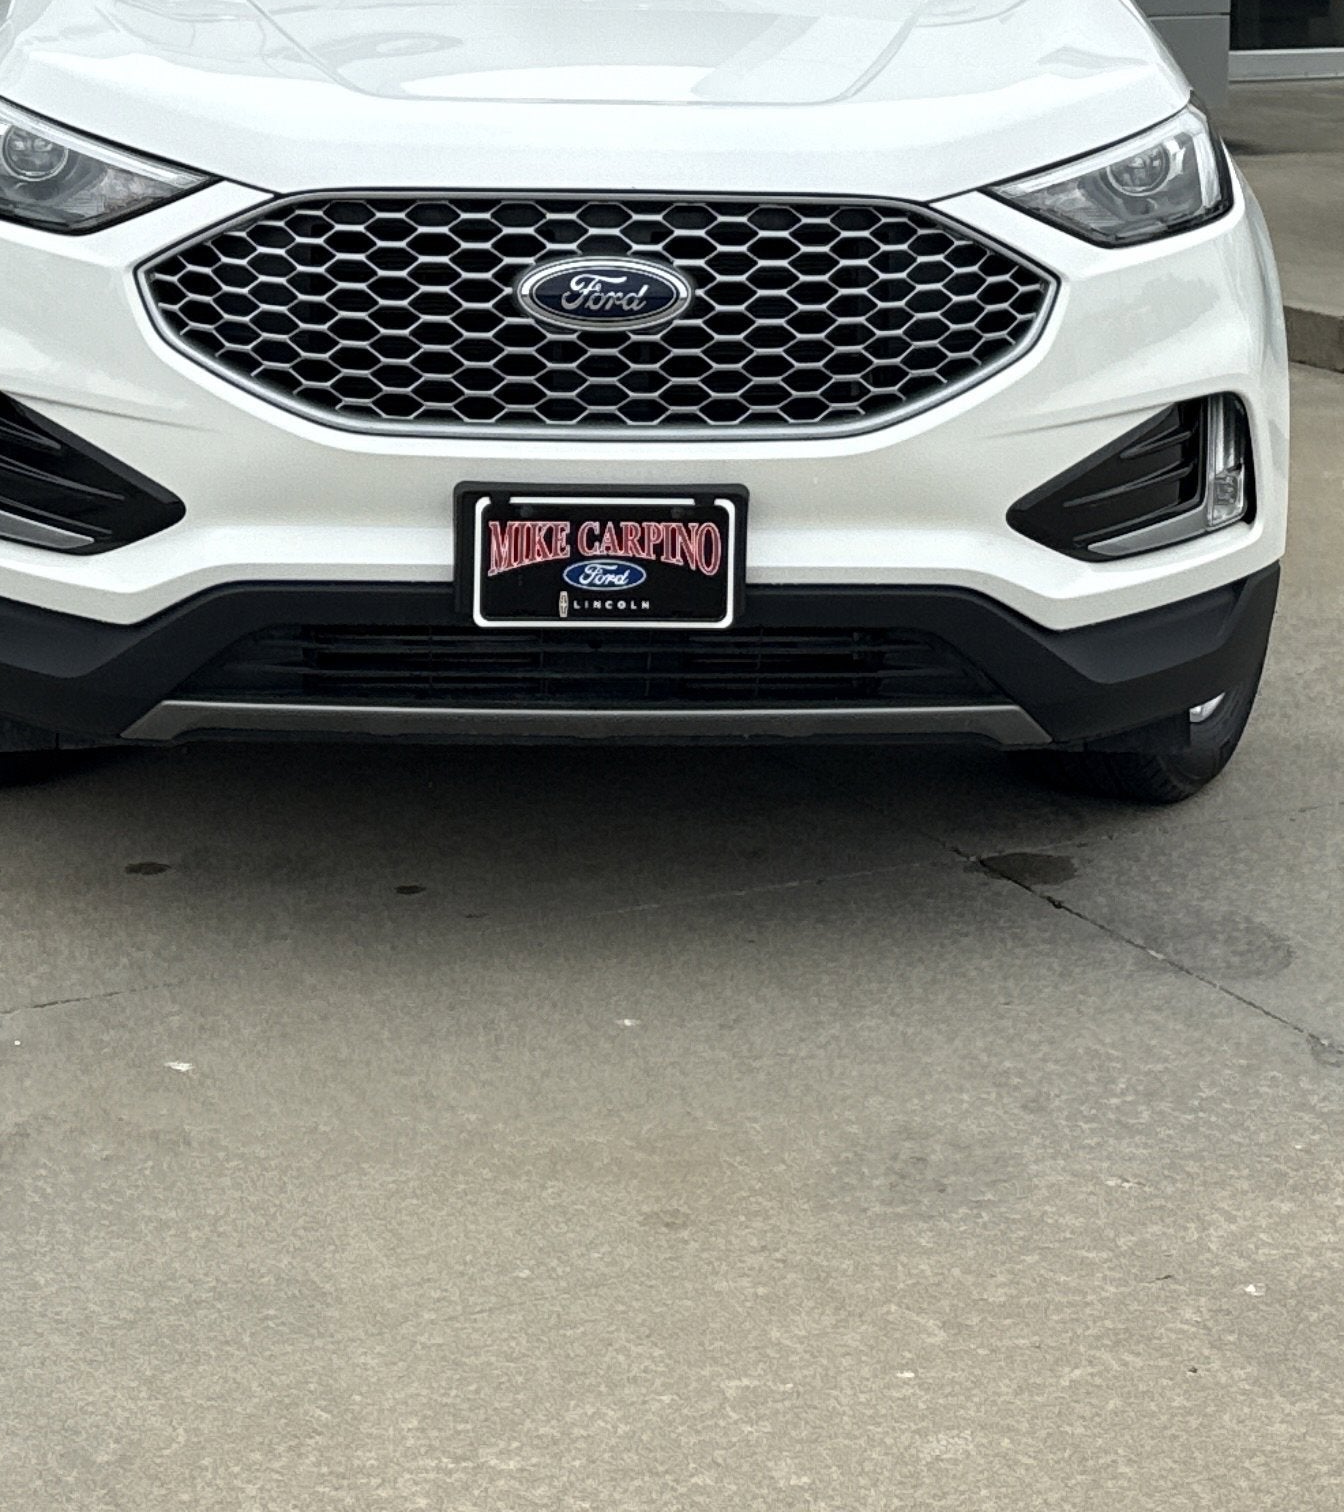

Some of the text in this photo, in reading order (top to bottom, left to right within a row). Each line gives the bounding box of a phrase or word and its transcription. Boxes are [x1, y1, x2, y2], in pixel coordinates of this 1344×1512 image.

[560, 273, 650, 311] Ford
[487, 520, 723, 577] MIKE CARPINO
[578, 563, 630, 587] Ford
[572, 599, 650, 611] LINCOLN
